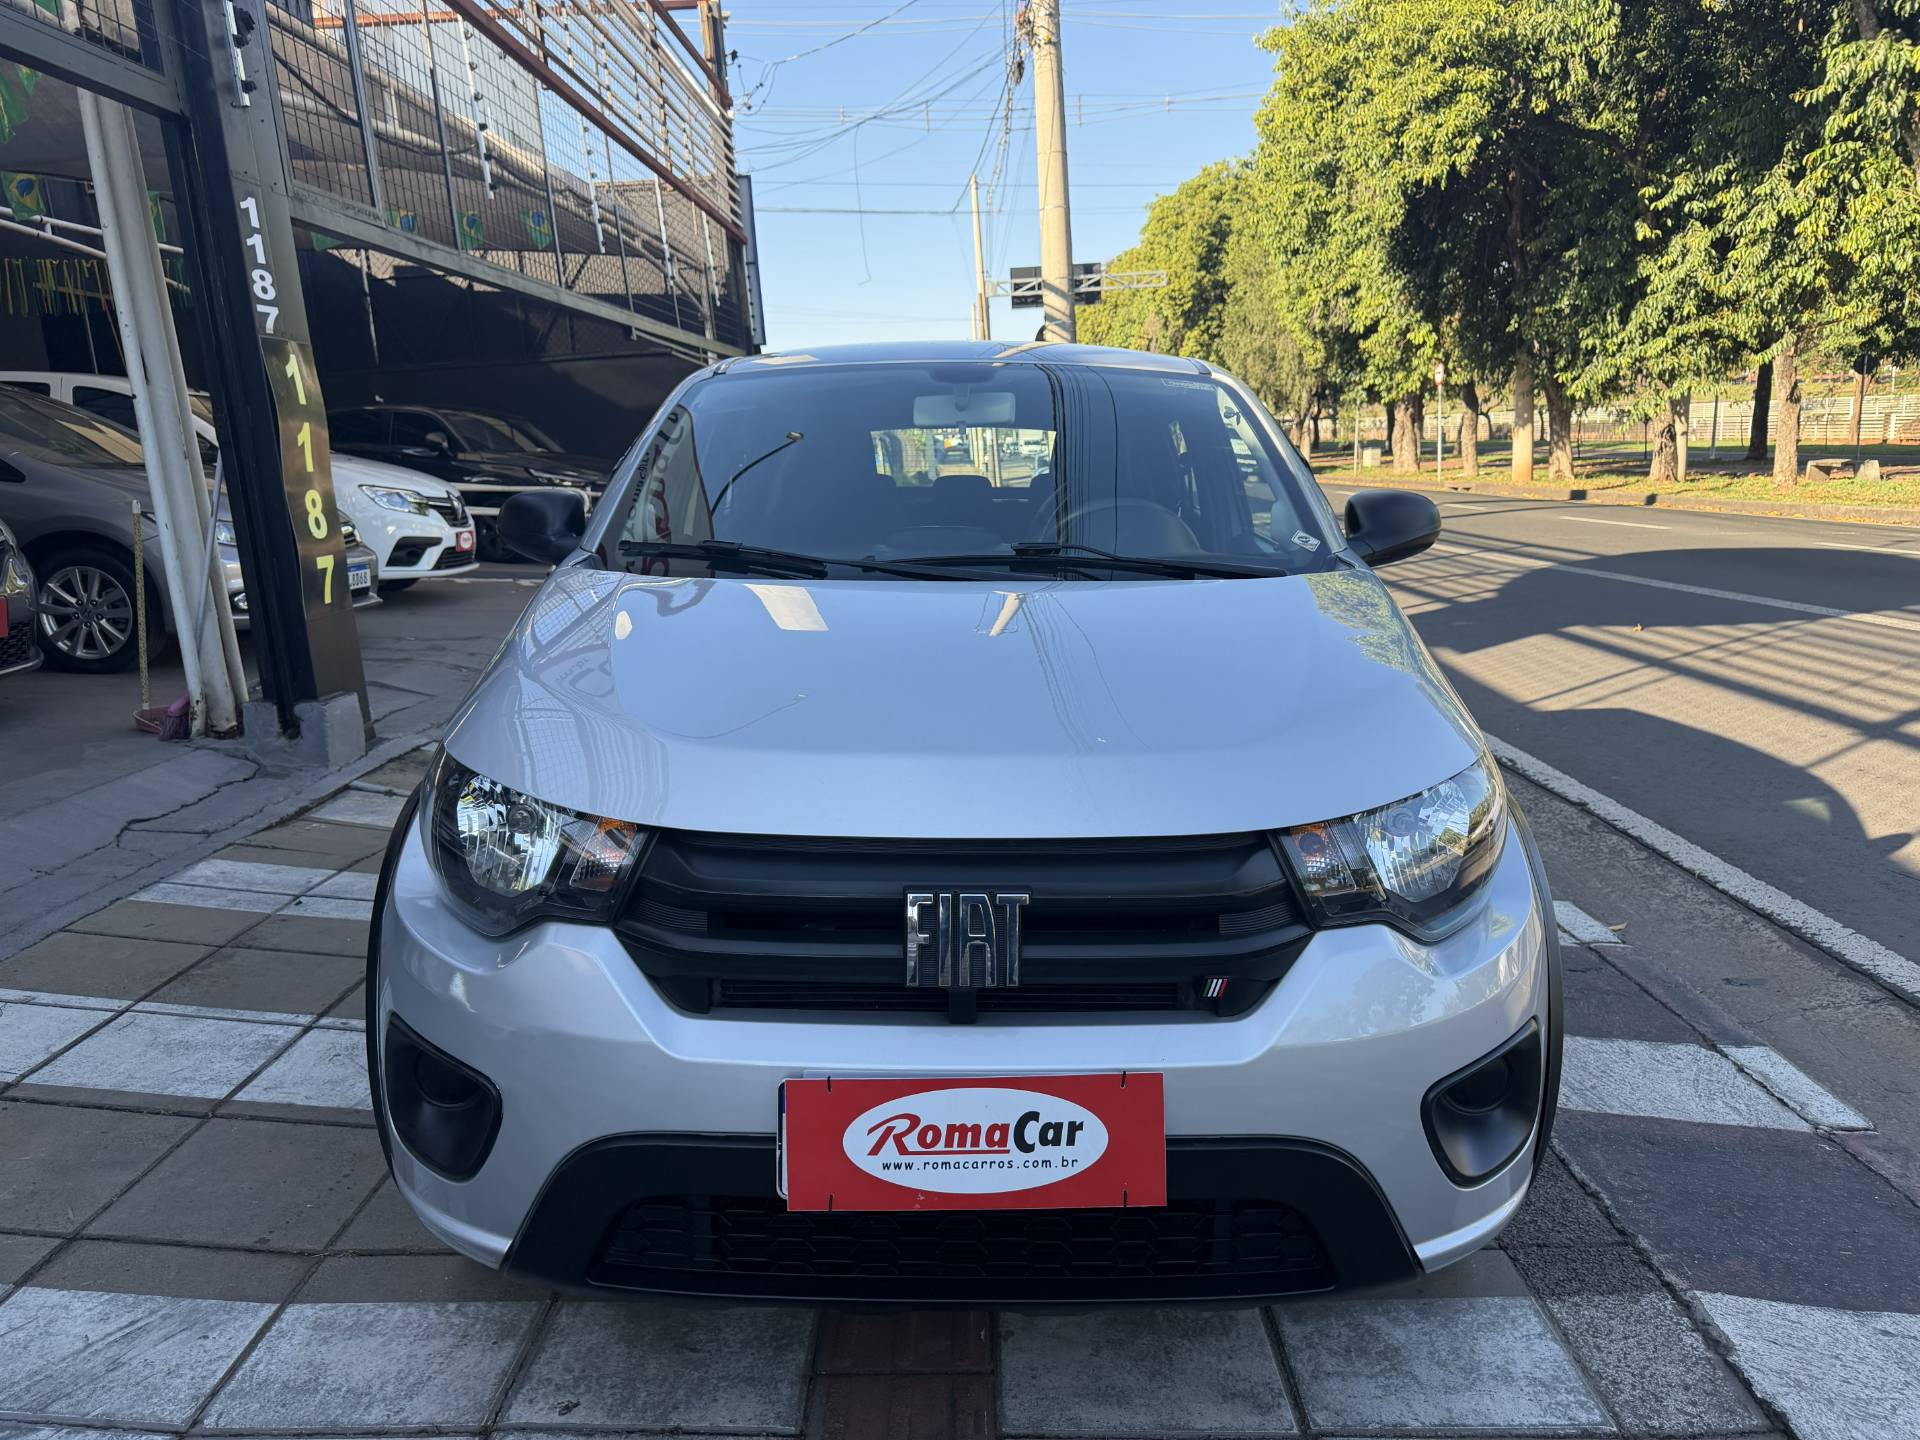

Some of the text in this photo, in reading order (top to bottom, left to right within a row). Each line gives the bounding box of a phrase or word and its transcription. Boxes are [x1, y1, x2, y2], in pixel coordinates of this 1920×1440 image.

[239, 197, 279, 334] 1187
[285, 354, 334, 604] 1187
[906, 893, 1030, 987] FIAT
[866, 1111, 1084, 1156] RomaCar
[881, 1155, 1079, 1171] www.romacarros.com.br
